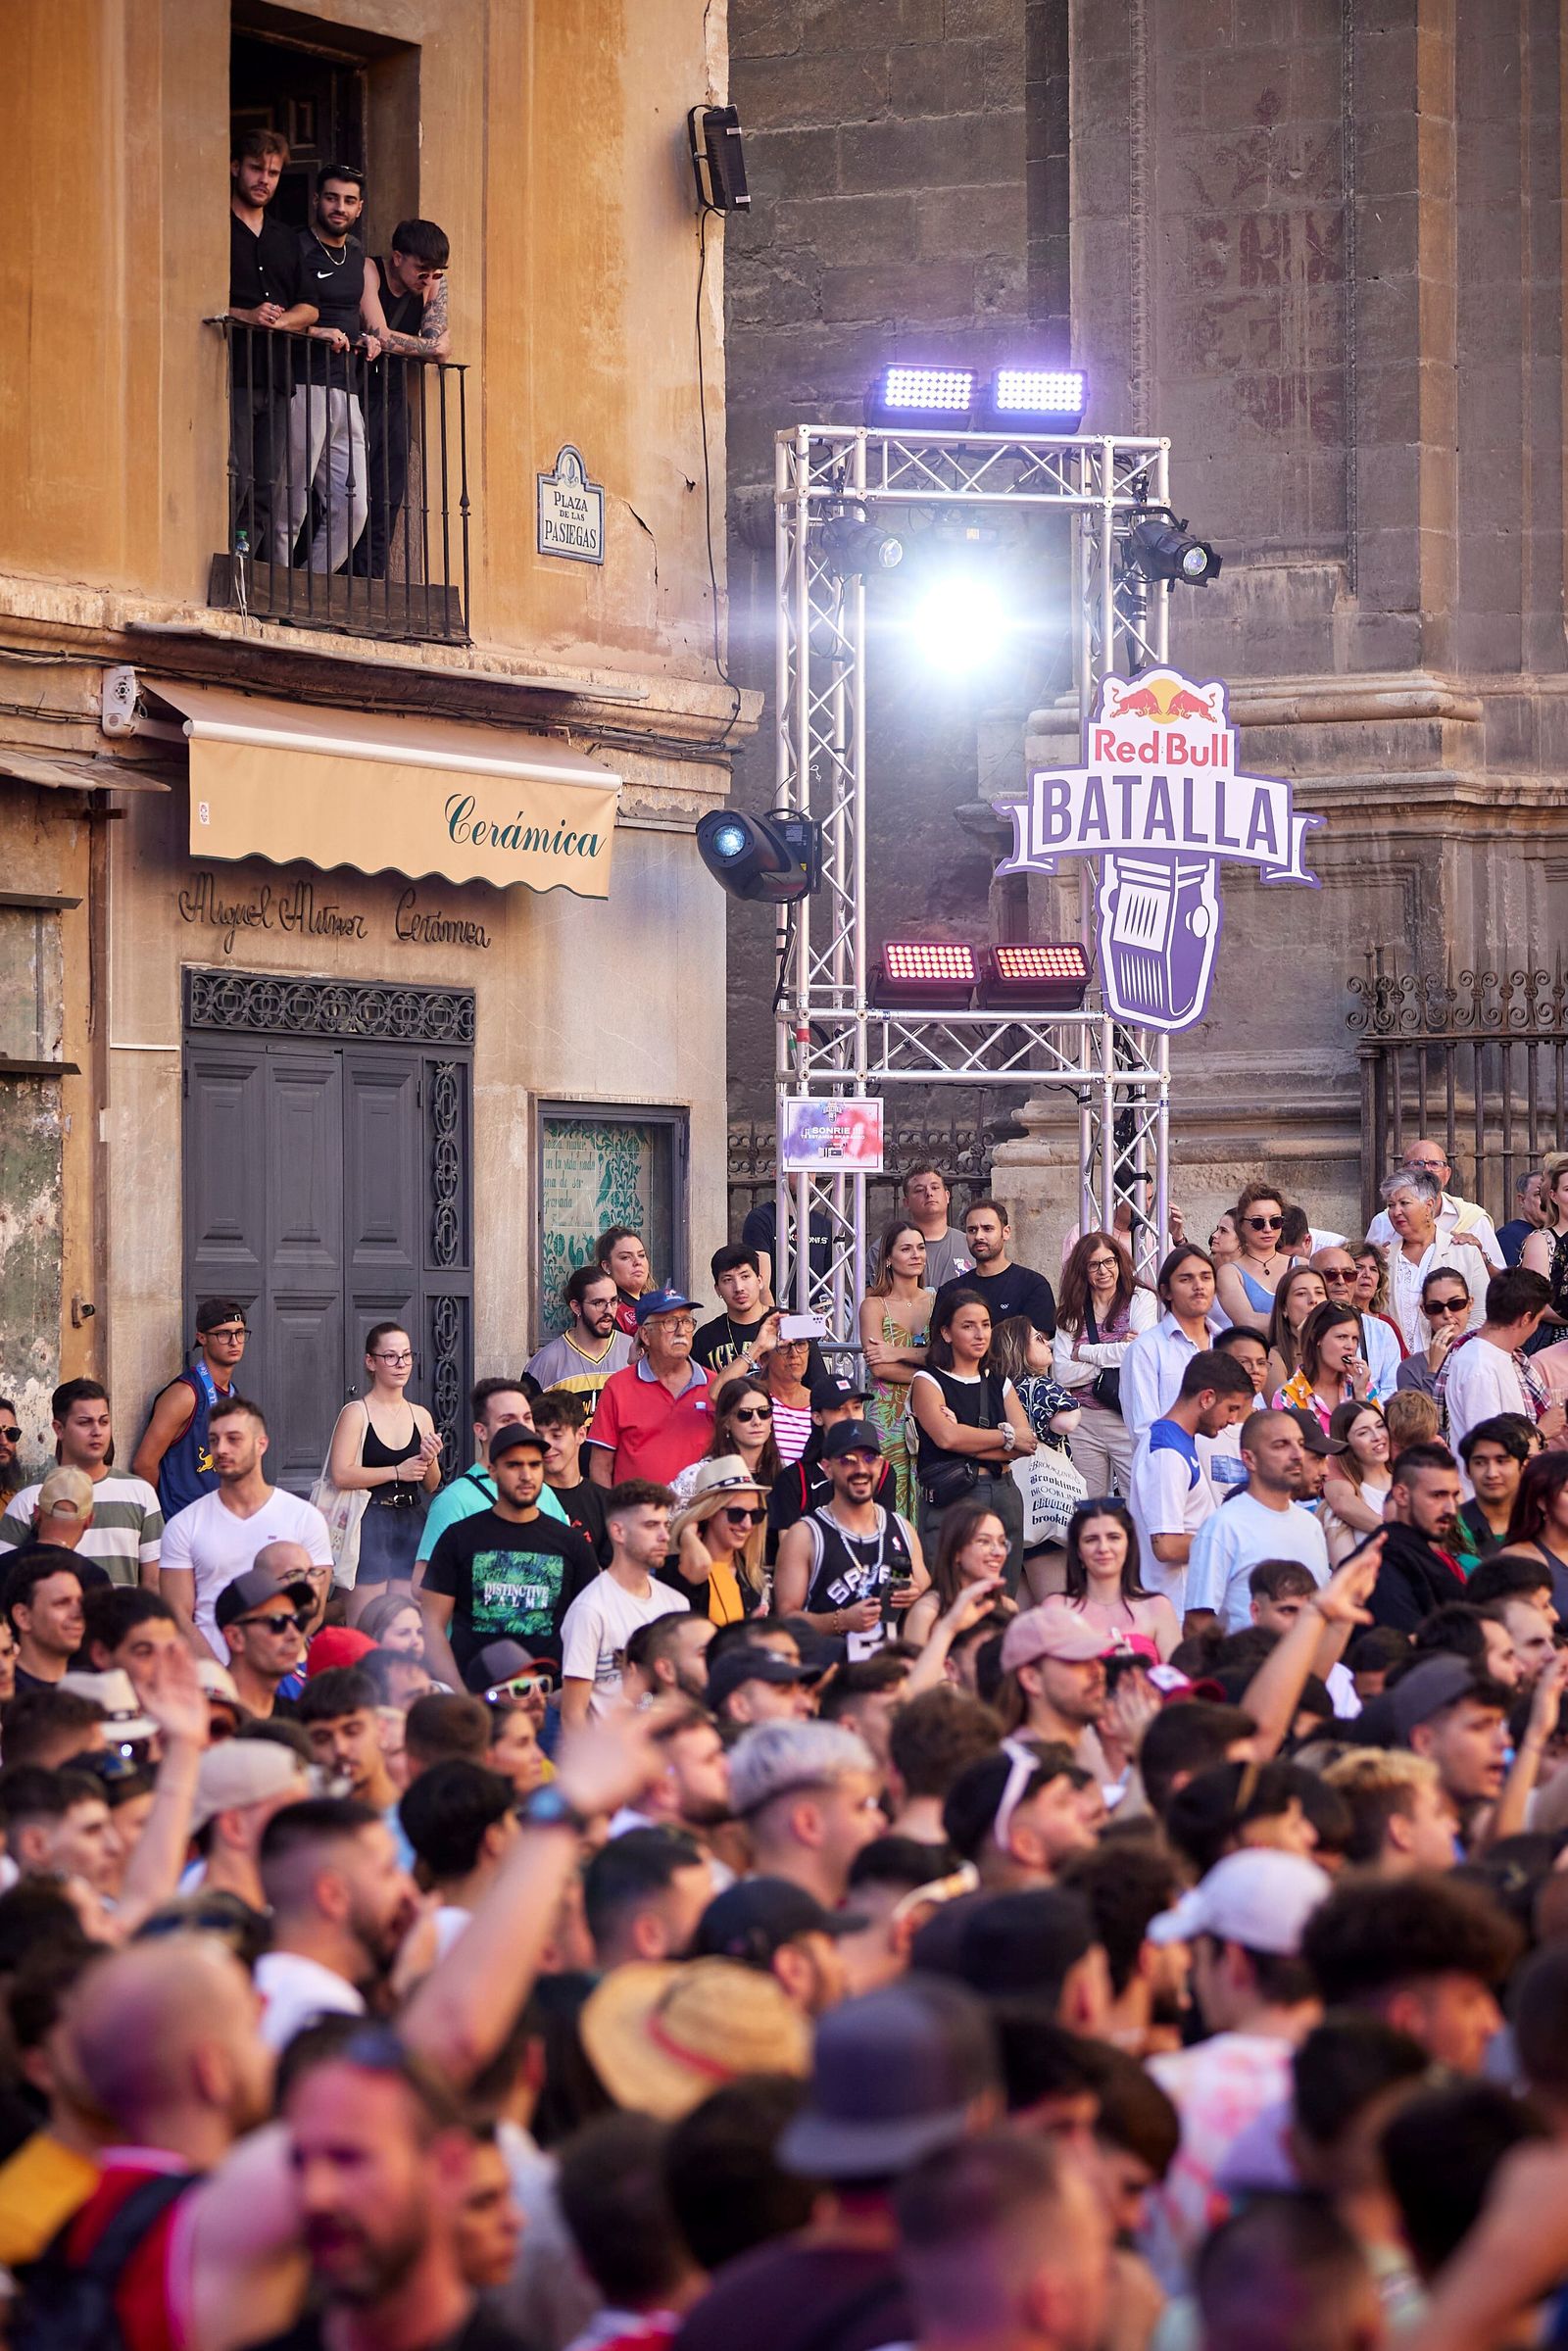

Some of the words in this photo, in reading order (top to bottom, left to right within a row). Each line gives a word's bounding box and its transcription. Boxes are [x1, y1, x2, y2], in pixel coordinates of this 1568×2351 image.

[554, 491, 588, 512] PLAZA
[571, 512, 585, 521] LAS
[545, 520, 596, 549] PASIEGAS
[1095, 729, 1160, 764] Red
[1166, 732, 1228, 767] Bull
[444, 793, 607, 857] Cerámica
[1042, 775, 1279, 856] BATALLA
[178, 871, 274, 955] Miguel
[395, 887, 492, 949] Cerámica
[484, 1582, 550, 1601] DISTINCTIVE
